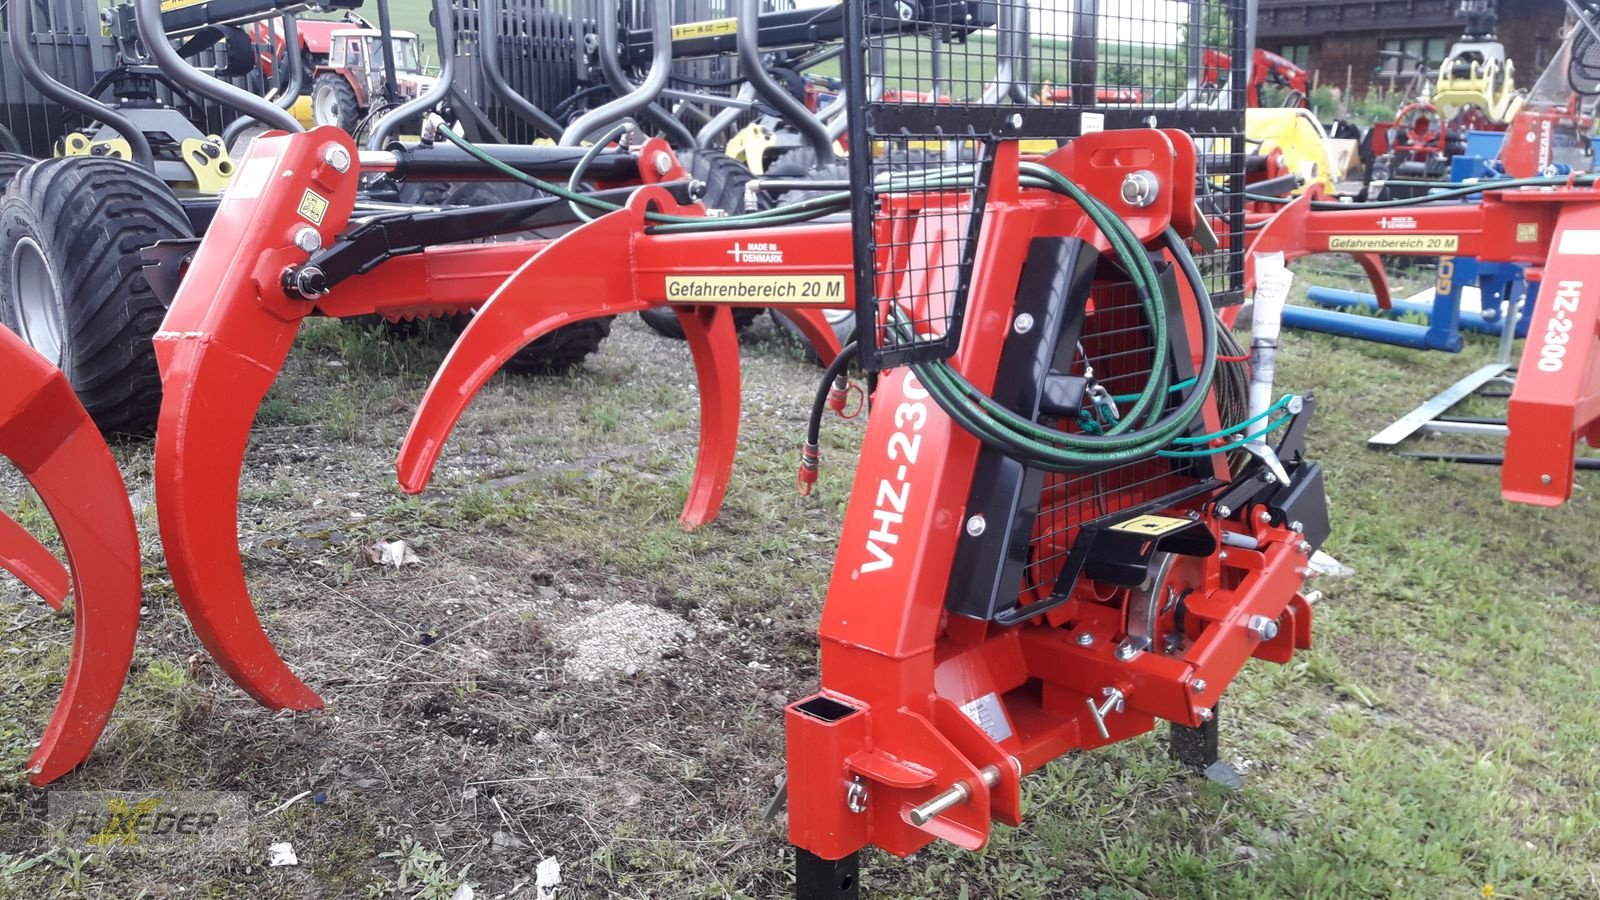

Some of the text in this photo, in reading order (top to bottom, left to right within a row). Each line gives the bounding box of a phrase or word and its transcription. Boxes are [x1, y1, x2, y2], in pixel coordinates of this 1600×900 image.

[748, 243, 777, 251] MADE IN
[1331, 239, 1456, 248] Gefahrenbereich 20 M
[742, 254, 783, 263] DENMARK
[669, 281, 841, 297] Gefahrenbereich 20 M
[1537, 280, 1584, 372] HZ-2300
[861, 334, 939, 572] VHZ-230
